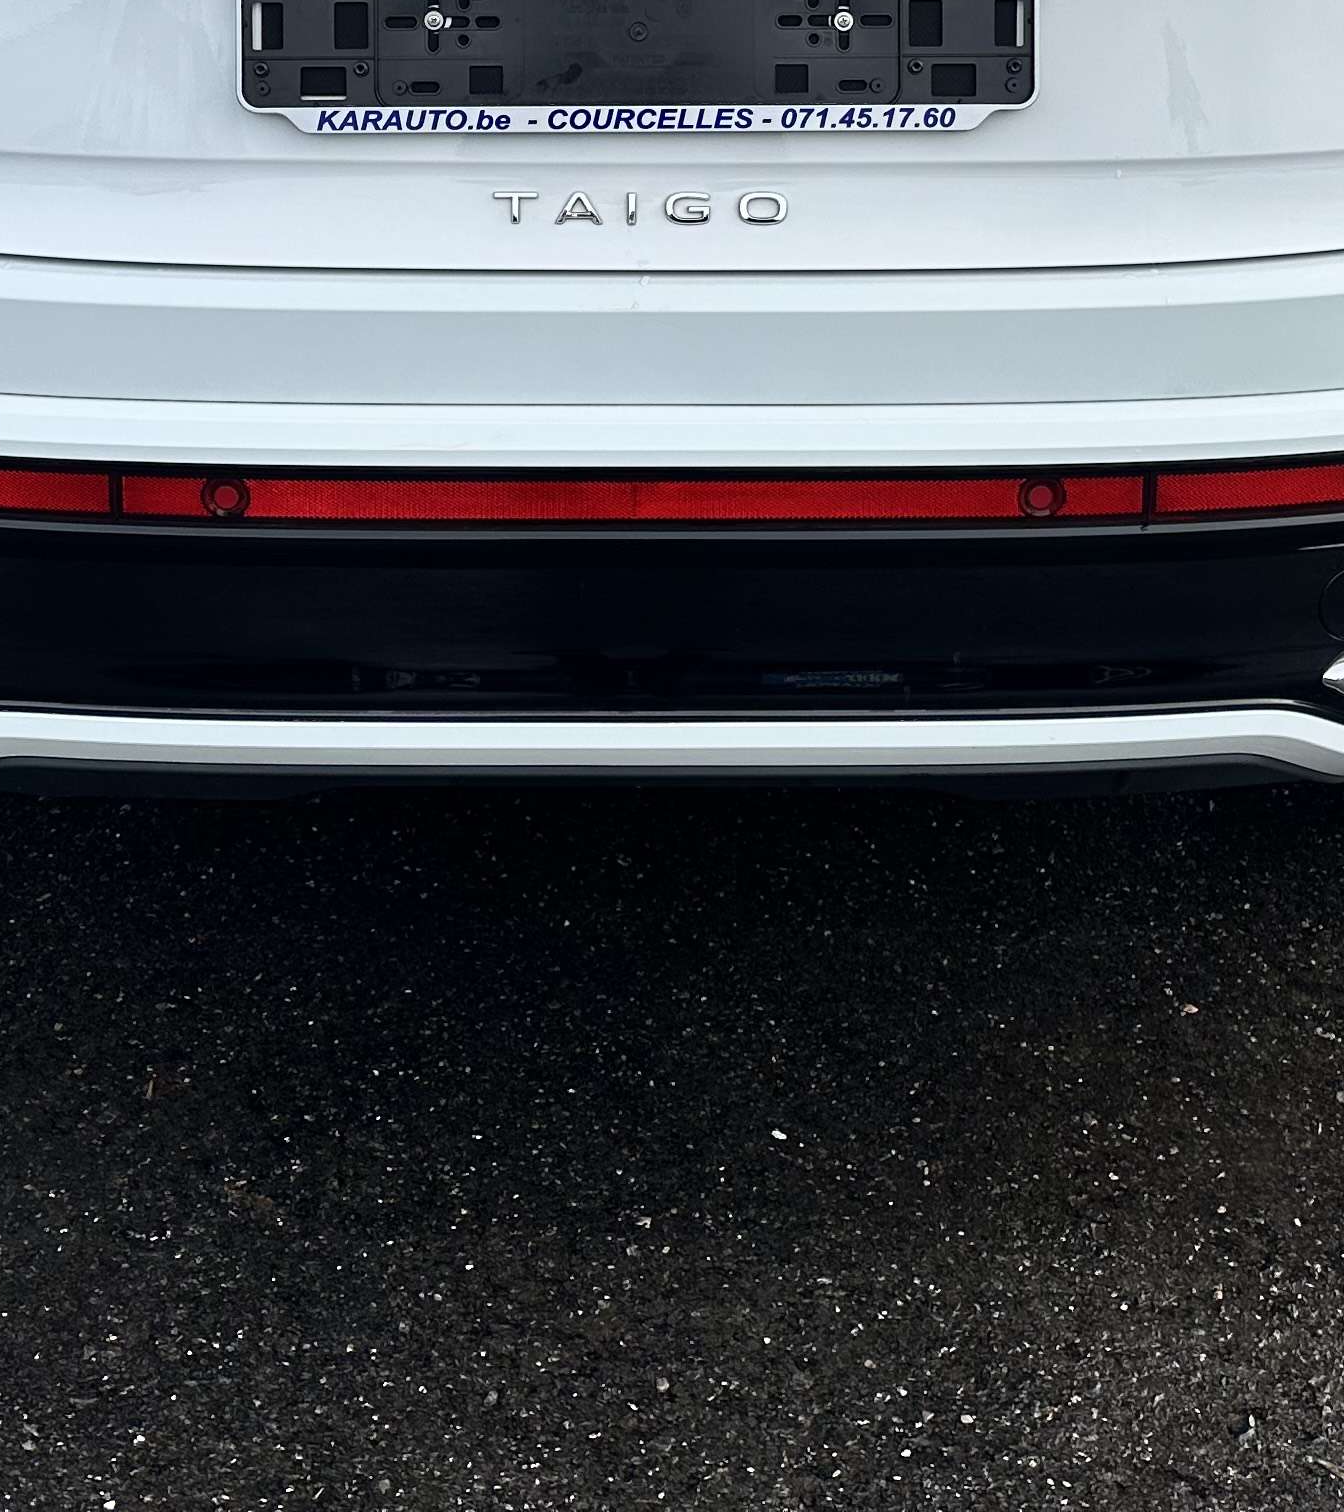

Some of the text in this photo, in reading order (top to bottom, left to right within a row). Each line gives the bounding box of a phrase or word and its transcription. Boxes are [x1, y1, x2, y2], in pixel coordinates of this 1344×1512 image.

[316, 109, 511, 131] KARAUTO.be
[547, 108, 754, 130] COURCELLES
[780, 106, 957, 130] 071.45.17.60
[492, 190, 789, 226] TAIGO
